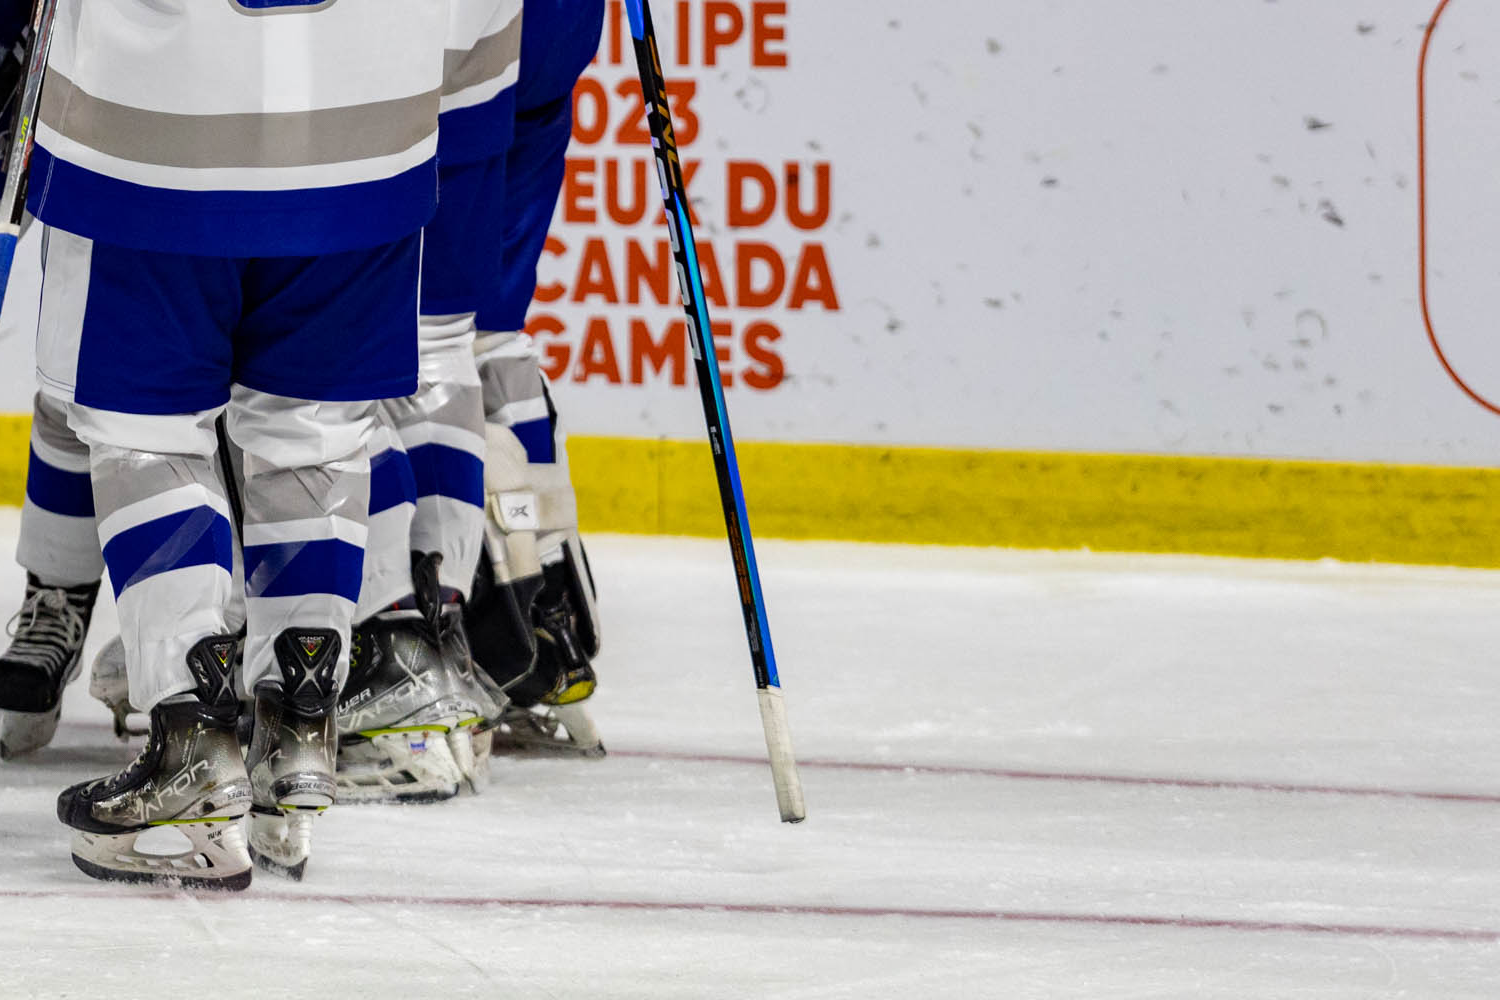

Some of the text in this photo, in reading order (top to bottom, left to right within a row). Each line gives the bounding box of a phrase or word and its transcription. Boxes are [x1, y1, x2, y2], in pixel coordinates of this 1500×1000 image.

[726, 162, 833, 231] DU
[533, 236, 841, 312] CANADA
[522, 312, 785, 390] GAMES
